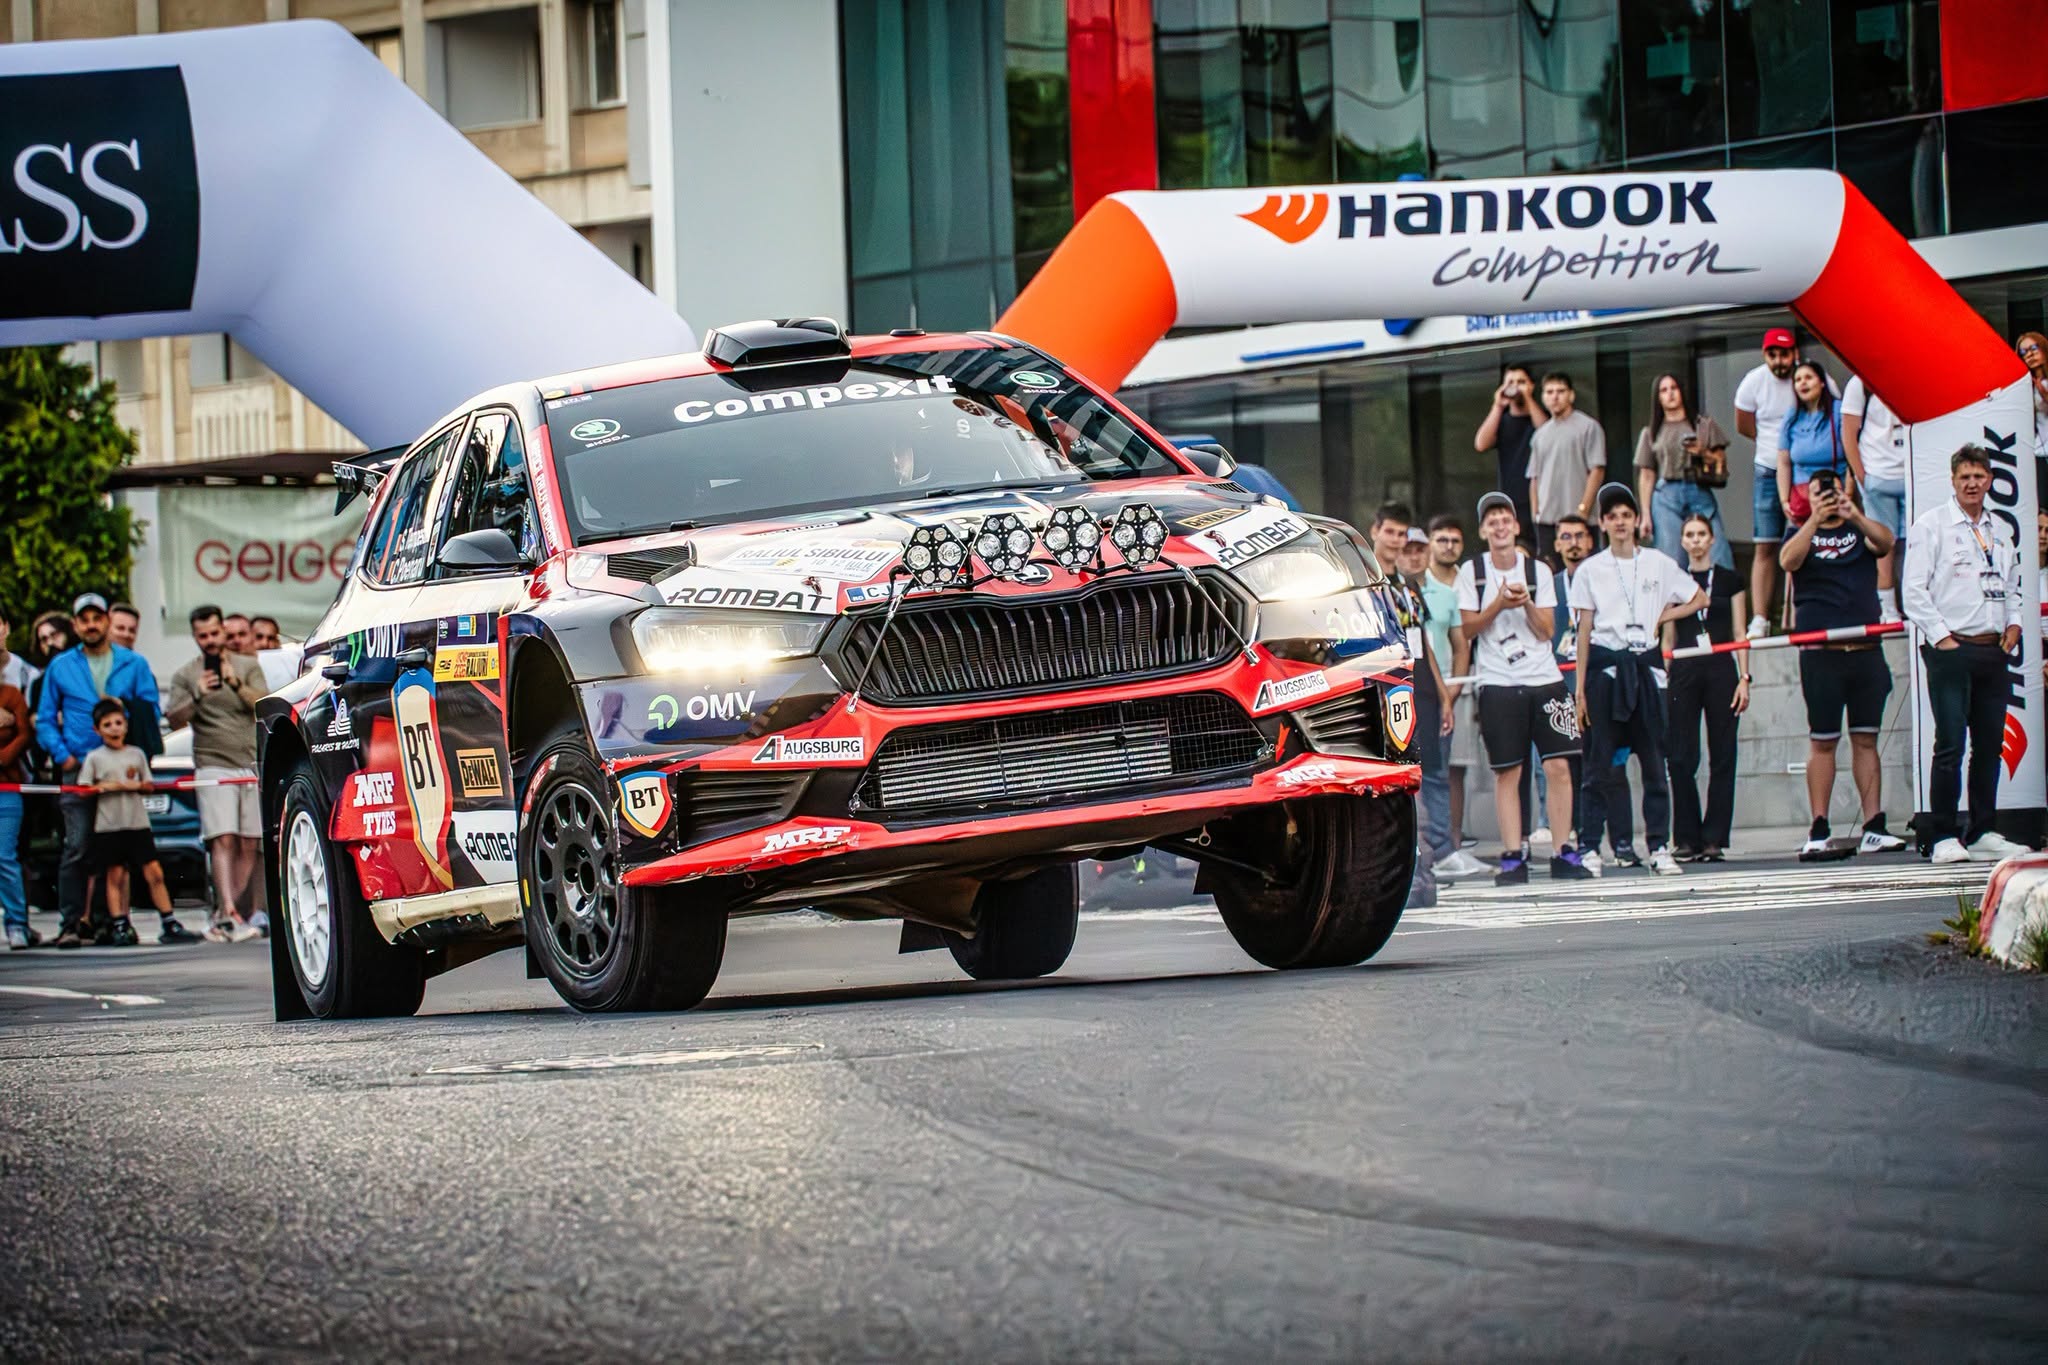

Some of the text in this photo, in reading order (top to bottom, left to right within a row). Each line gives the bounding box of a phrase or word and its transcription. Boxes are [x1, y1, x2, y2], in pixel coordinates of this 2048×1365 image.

[0, 138, 149, 254] SS
[1432, 233, 1762, 302] Competition
[1218, 518, 1302, 566] ROMBAT
[195, 539, 354, 584] GEIGE
[804, 549, 890, 562] SIBIULUI
[667, 587, 833, 612] ROMBAT
[1274, 673, 1325, 698] AUGSBURG
[686, 690, 756, 721] OMV
[1393, 700, 1410, 723] BT
[403, 722, 437, 790] BT
[784, 740, 860, 755] AUGSBURG
[1277, 764, 1337, 788] MRF
[353, 771, 395, 808] MRF
[629, 786, 659, 810] BT
[362, 811, 396, 837] TYRES
[760, 826, 852, 853] MRF
